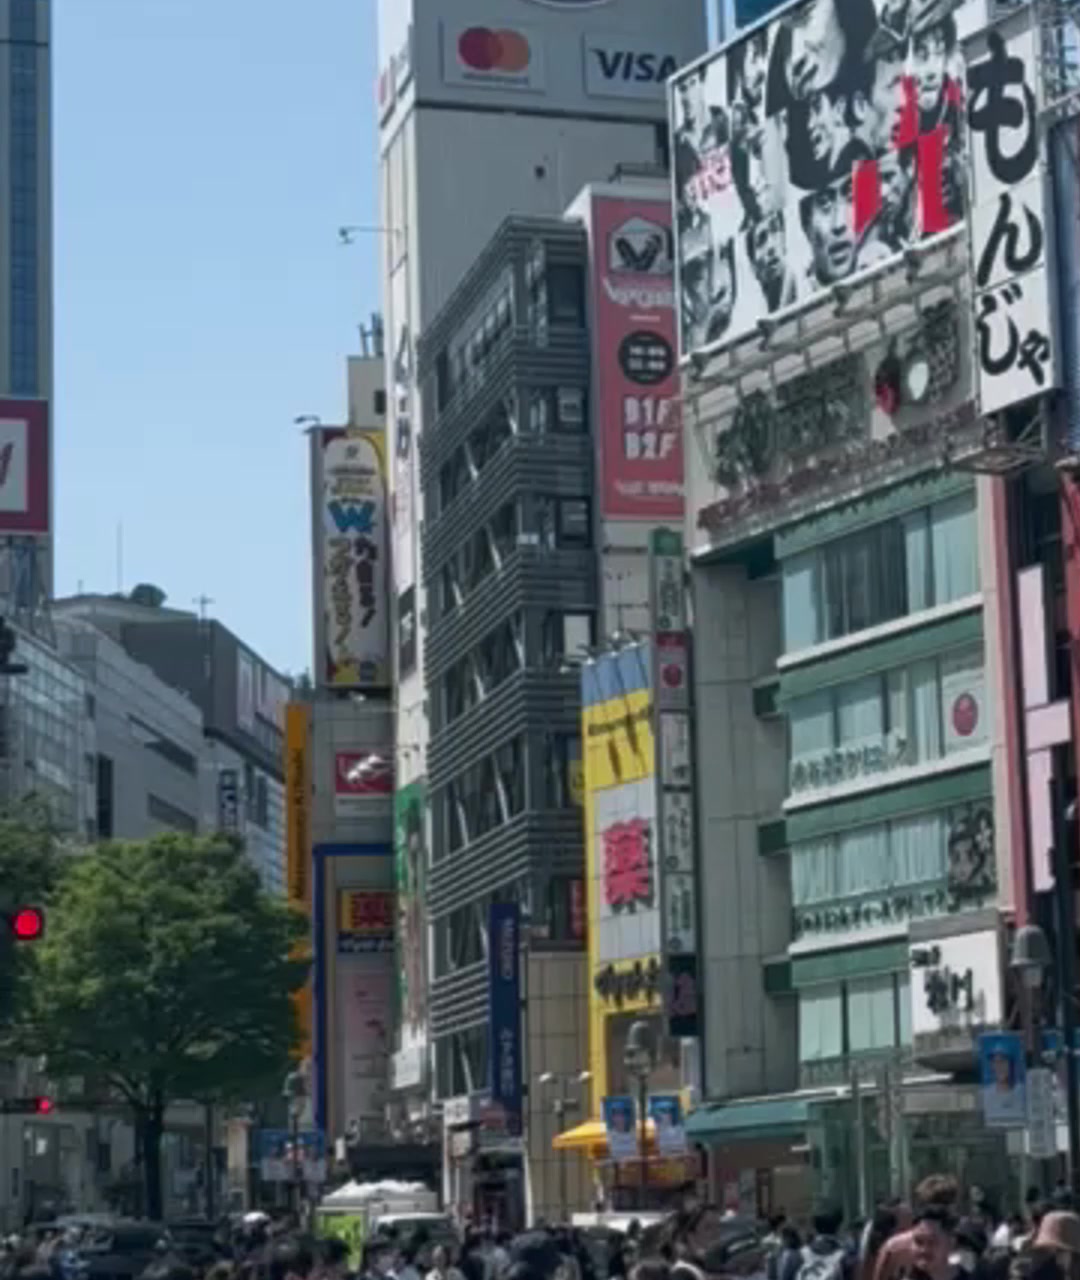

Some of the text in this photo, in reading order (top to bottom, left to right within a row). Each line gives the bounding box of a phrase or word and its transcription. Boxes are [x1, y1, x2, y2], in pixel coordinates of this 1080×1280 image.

[591, 48, 680, 84] VISA
[967, 31, 1050, 386] もんじゃ
